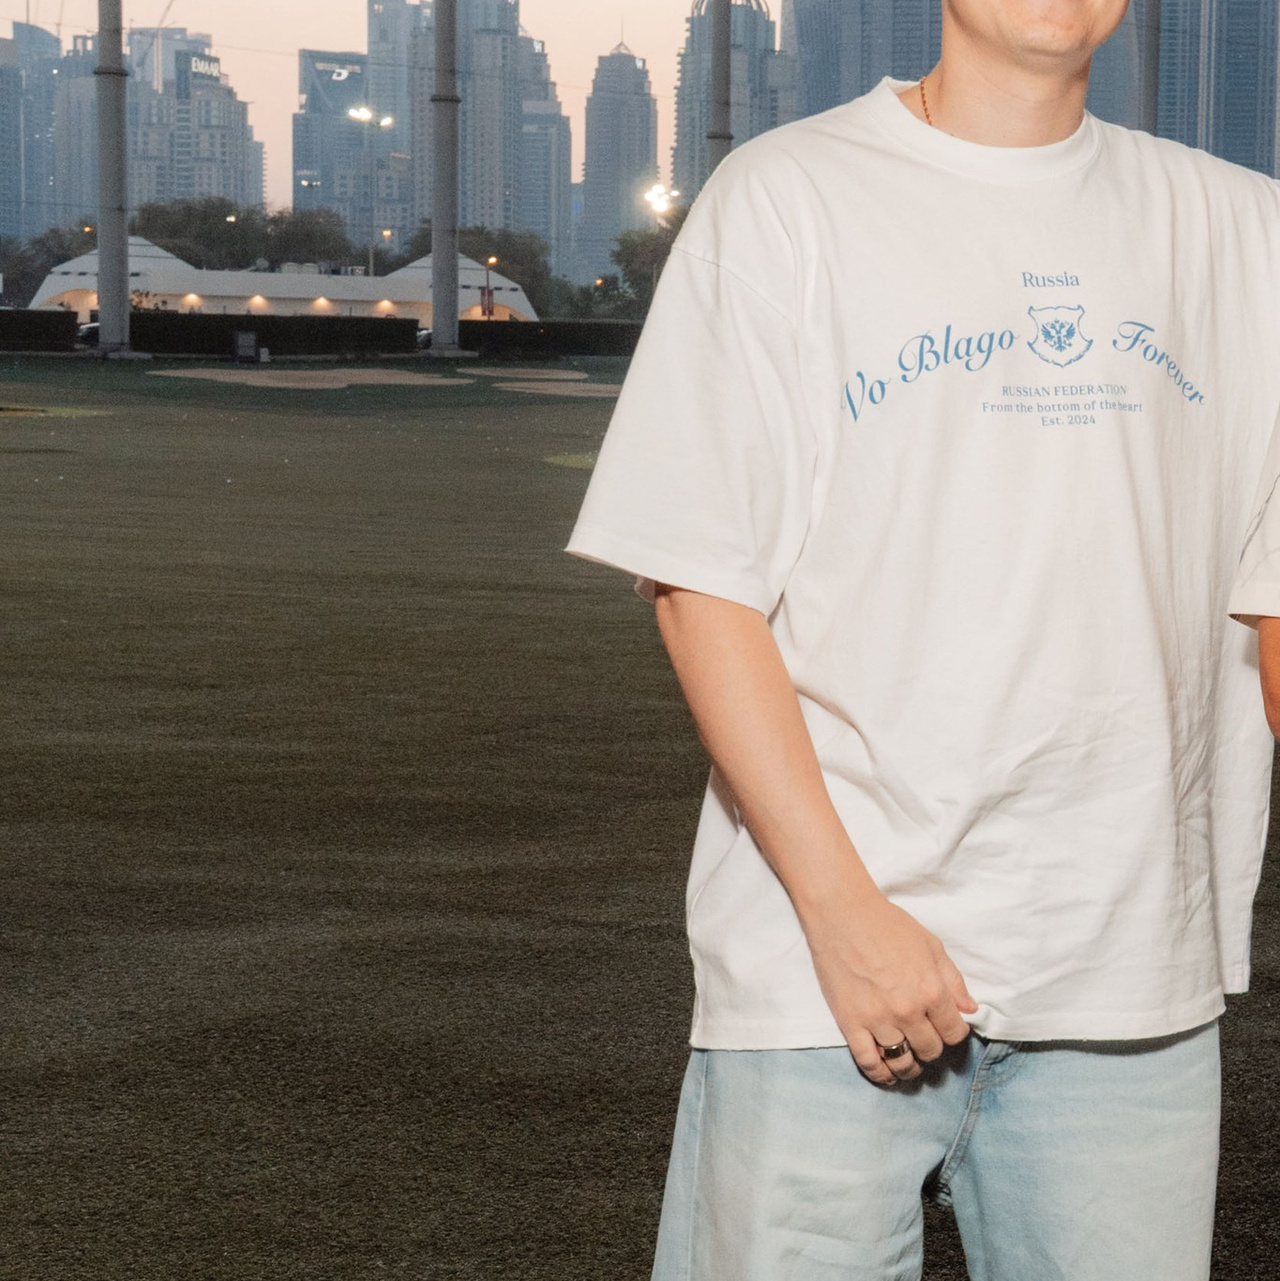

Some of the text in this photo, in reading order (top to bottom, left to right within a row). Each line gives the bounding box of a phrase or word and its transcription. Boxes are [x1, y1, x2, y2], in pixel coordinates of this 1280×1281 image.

[1021, 271, 1080, 287] Russia
[840, 320, 1206, 422] Vo Blago Forever
[1002, 384, 1127, 397] RUSSIAN FEDERATION
[982, 402, 1013, 412] From
[1016, 402, 1033, 413] the
[1037, 402, 1080, 413] bottom
[1083, 400, 1096, 411] of
[1100, 400, 1117, 410] the
[1041, 415, 1096, 426] Est. 2024
